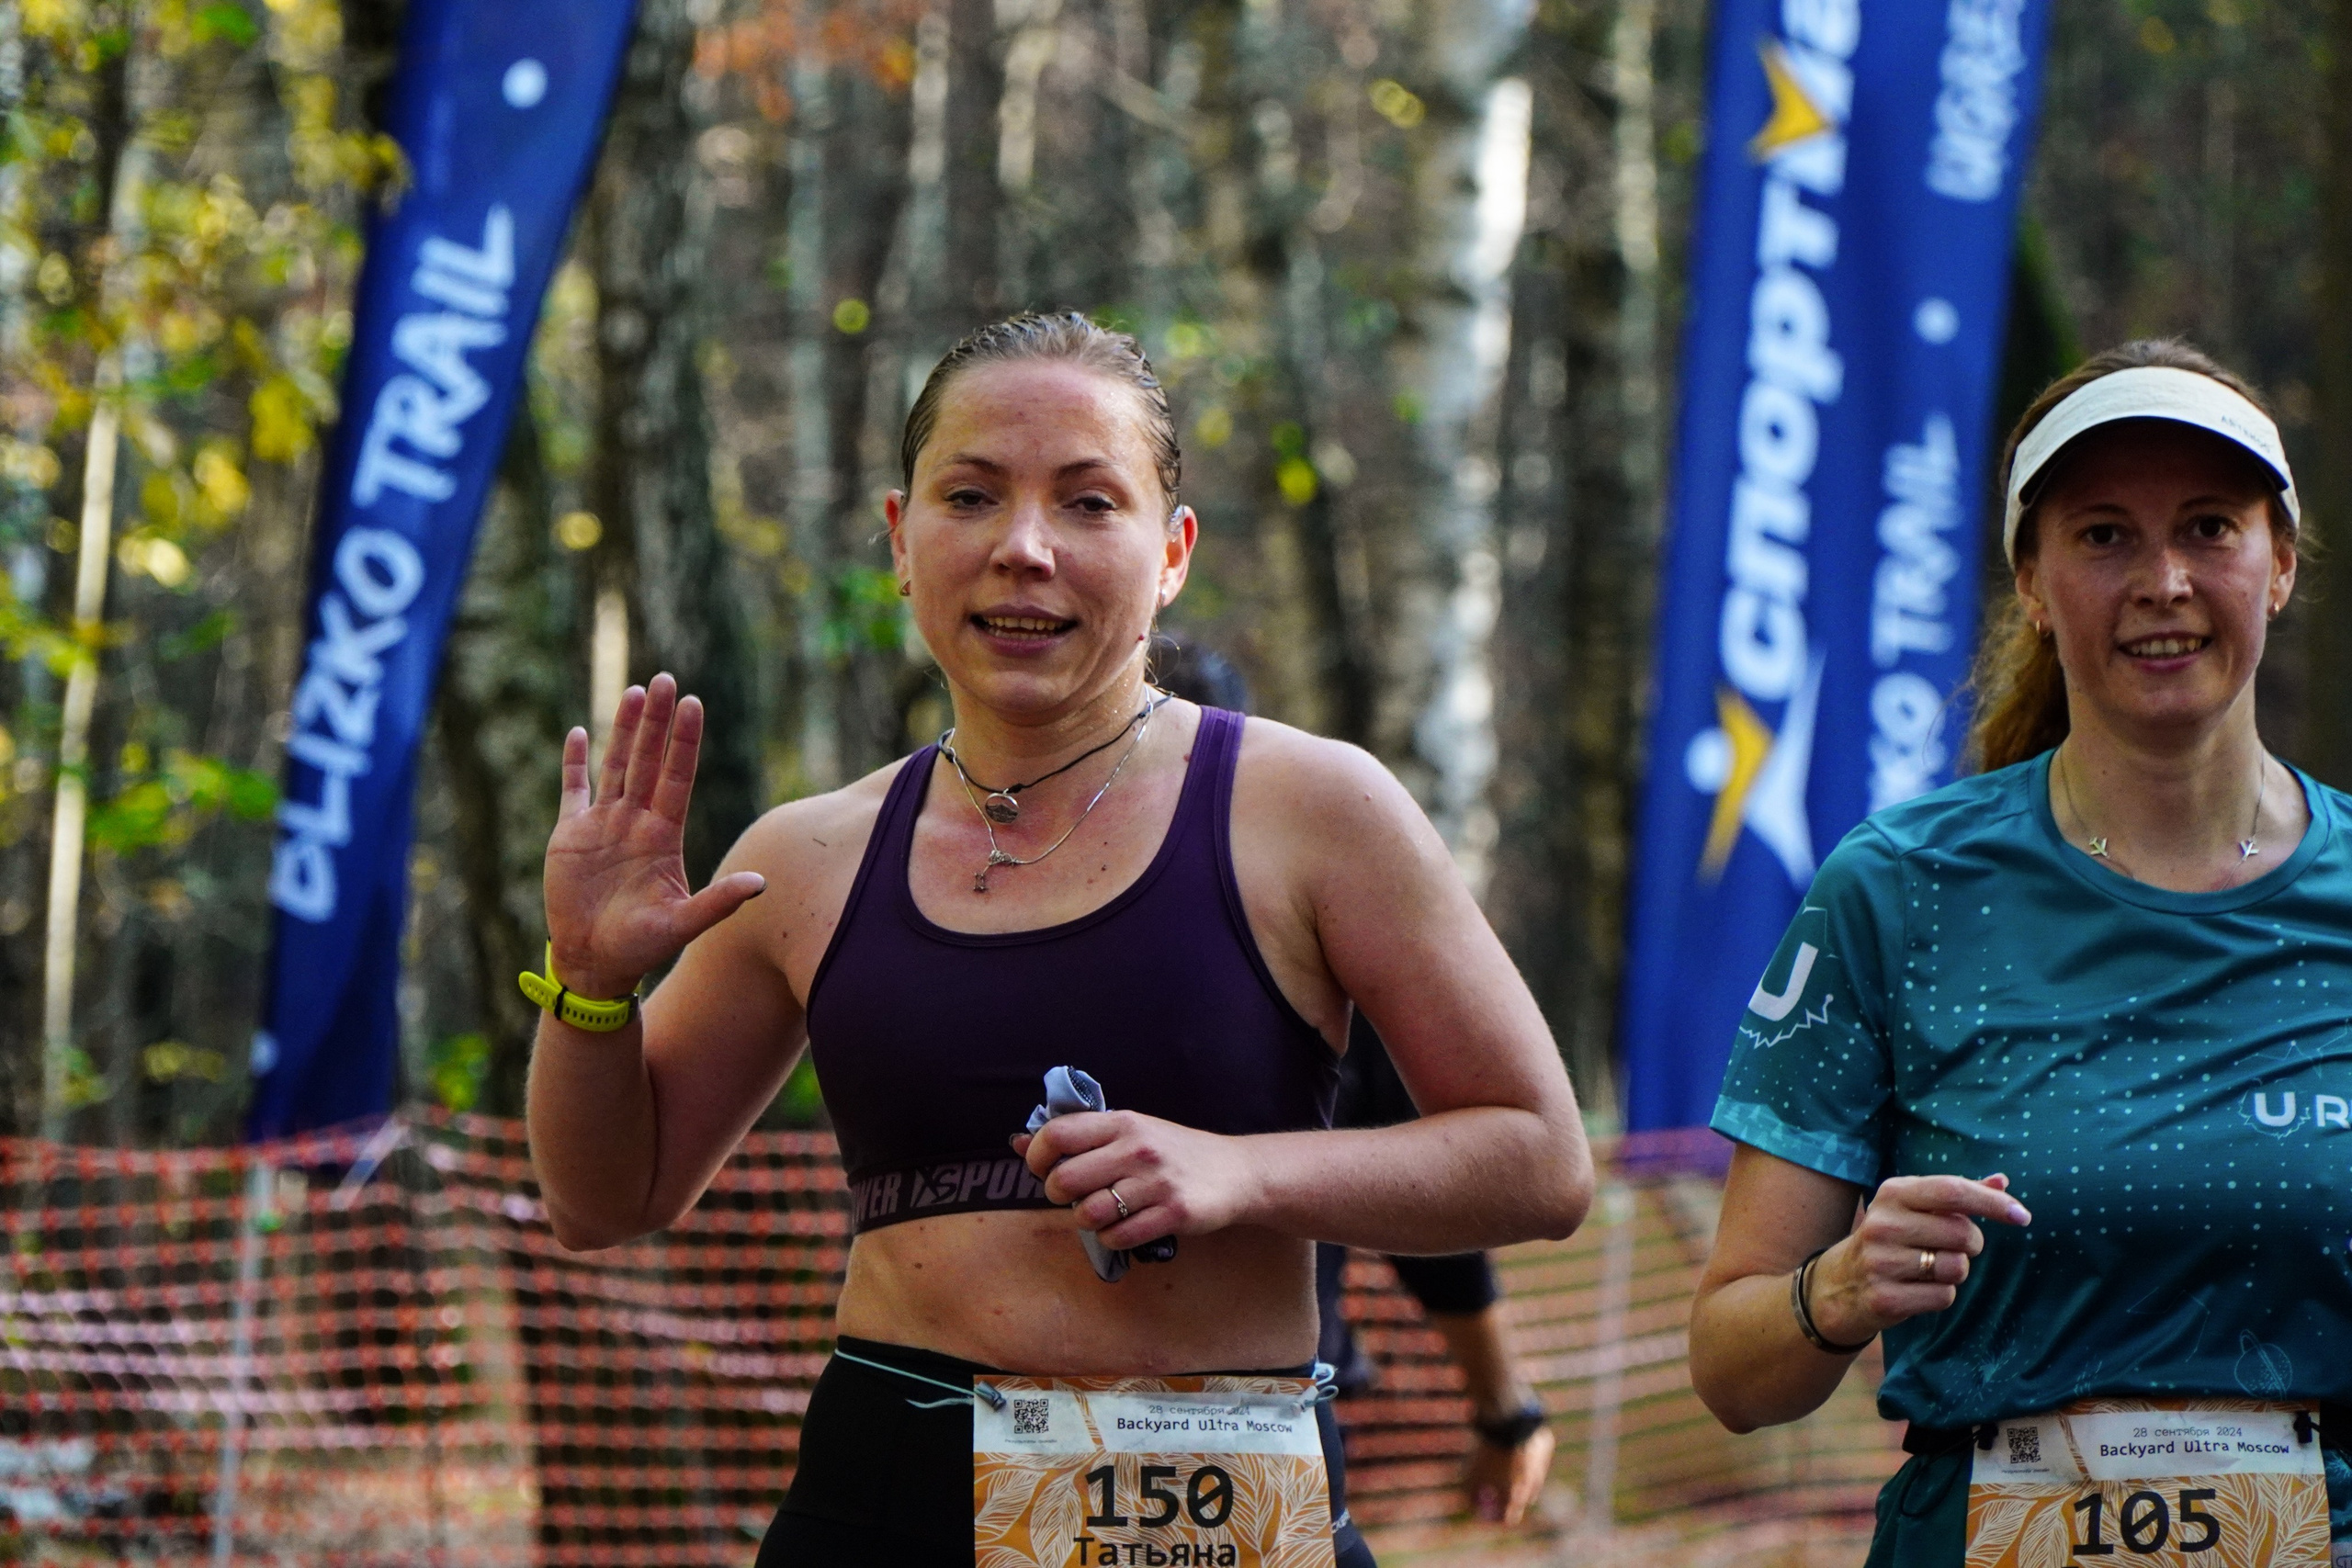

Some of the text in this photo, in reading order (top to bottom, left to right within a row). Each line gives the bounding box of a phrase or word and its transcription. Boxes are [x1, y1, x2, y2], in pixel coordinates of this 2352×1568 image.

[353, 203, 514, 507] TRAIL
[2254, 1091, 2352, 1129] U R
[1116, 1417, 1293, 1433] Backyard Ultra Moscow
[1149, 1404, 1164, 1415] 28
[1170, 1404, 1225, 1416] сентября
[2132, 1427, 2243, 1438] 28 сентября 2024
[2100, 1439, 2290, 1458] Backyard Ultra Moscow
[1084, 1465, 1234, 1529] 150
[2073, 1488, 2221, 1556] 105
[1074, 1536, 1237, 1567] Татьяна
